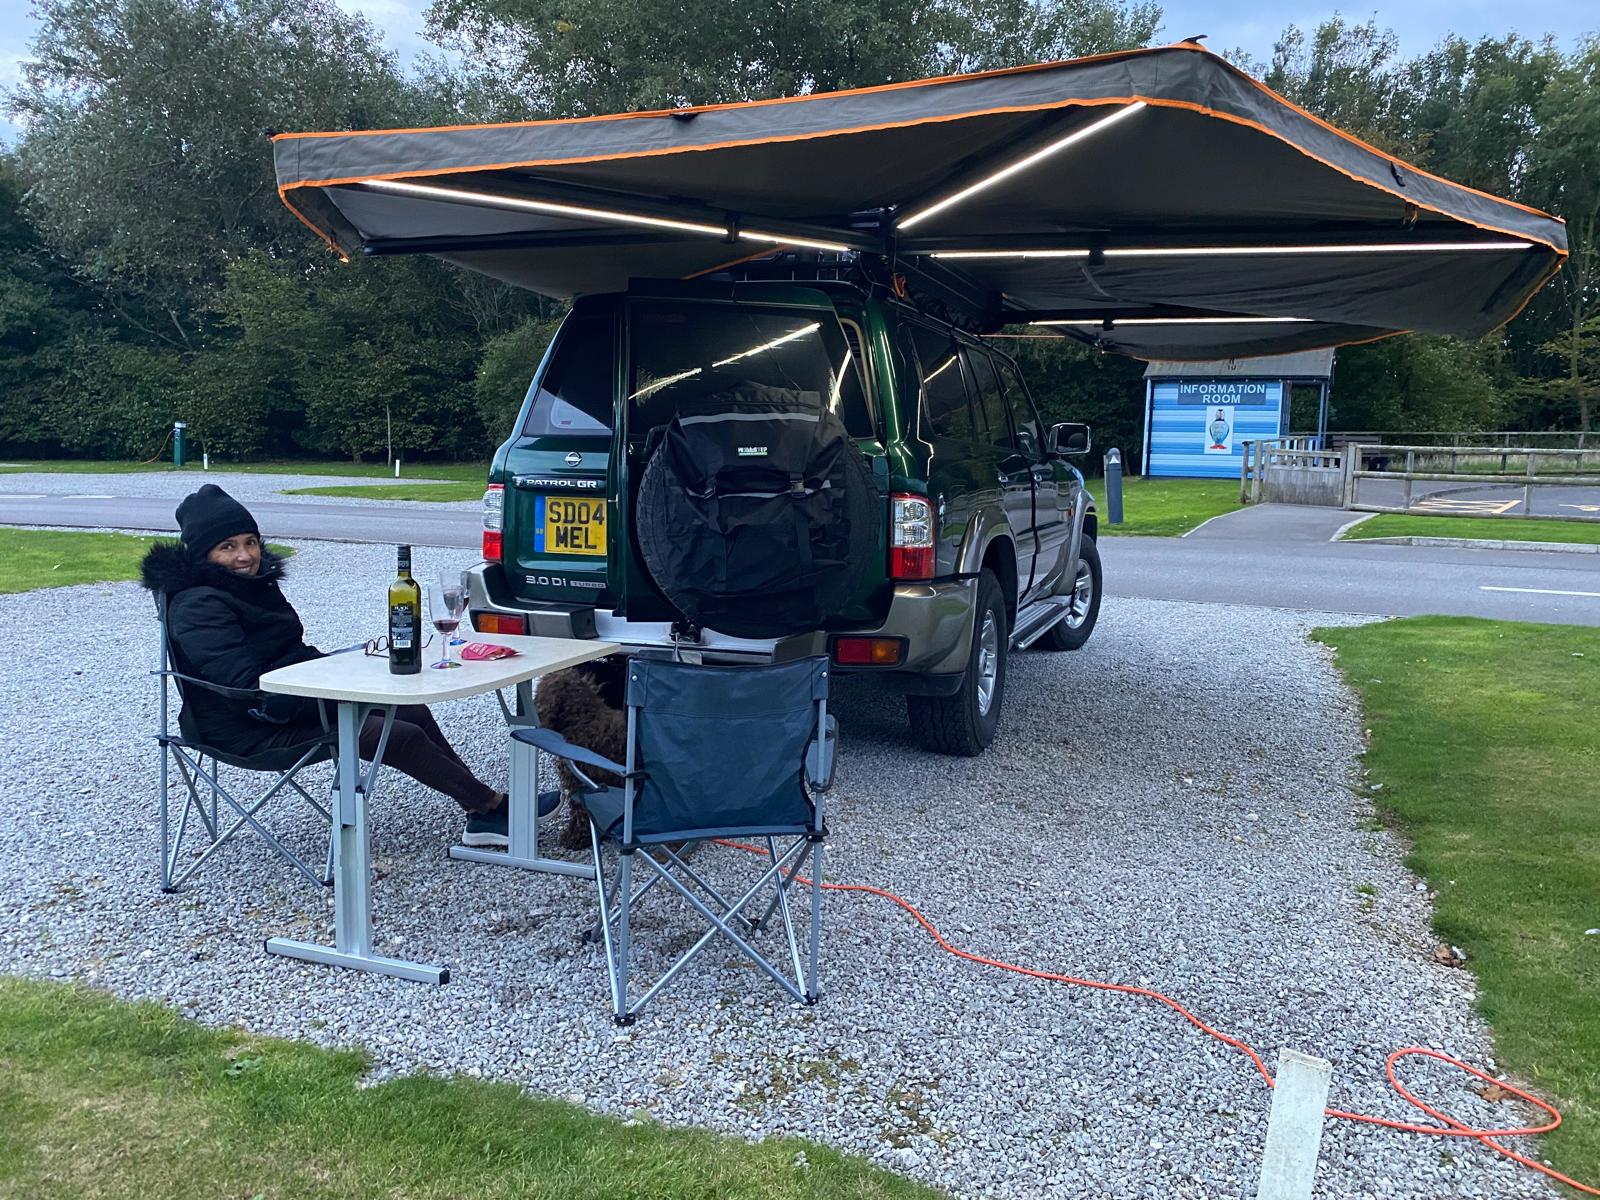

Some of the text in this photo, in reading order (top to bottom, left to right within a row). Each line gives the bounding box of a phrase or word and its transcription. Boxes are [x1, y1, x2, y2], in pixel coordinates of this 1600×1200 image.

[1180, 384, 1265, 394] INFORMATION
[1202, 394, 1241, 404] ROOM
[526, 479, 597, 489] PATROL GR
[549, 501, 605, 526] SD04
[555, 526, 597, 549] MEL
